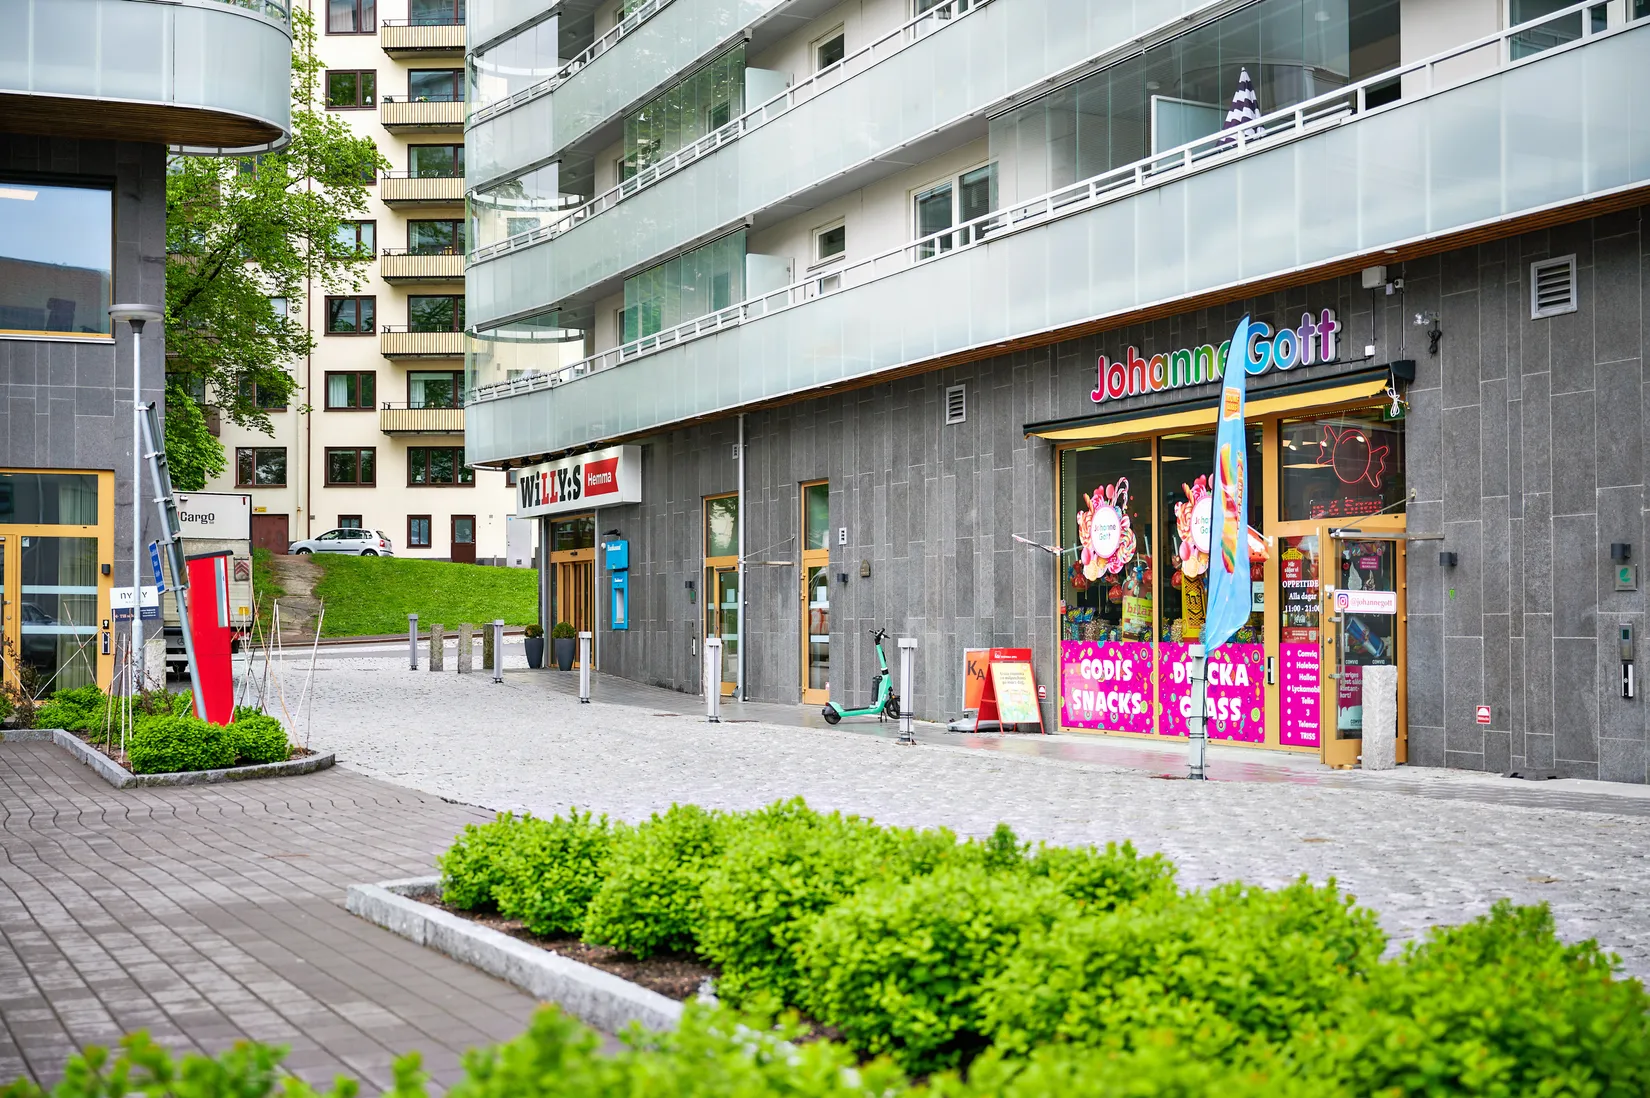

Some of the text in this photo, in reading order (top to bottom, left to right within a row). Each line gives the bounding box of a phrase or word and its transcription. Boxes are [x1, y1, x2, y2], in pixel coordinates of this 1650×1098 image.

[1244, 308, 1339, 376] Gott
[587, 471, 612, 487] Hemma
[1194, 516, 1210, 525] Joha
[1093, 523, 1117, 532] Johanne
[1200, 525, 1209, 535] Go
[1098, 532, 1111, 541] Gott
[1288, 592, 1317, 602] Alla dagar
[1285, 604, 1301, 612] 11:00
[1350, 598, 1393, 609] @johannegott
[1126, 601, 1153, 617] bilar
[1297, 649, 1318, 659] Comviq
[1080, 658, 1133, 682] GODIS
[1296, 661, 1319, 671] Halebop
[1298, 673, 1317, 681] Hallon
[1072, 688, 1142, 715] SNACKS
[1301, 696, 1315, 705] Telia
[1179, 695, 1242, 722] GASS
[1305, 708, 1310, 716] 3
[1297, 720, 1319, 729] Telenor
[1300, 731, 1316, 741] TRISS
